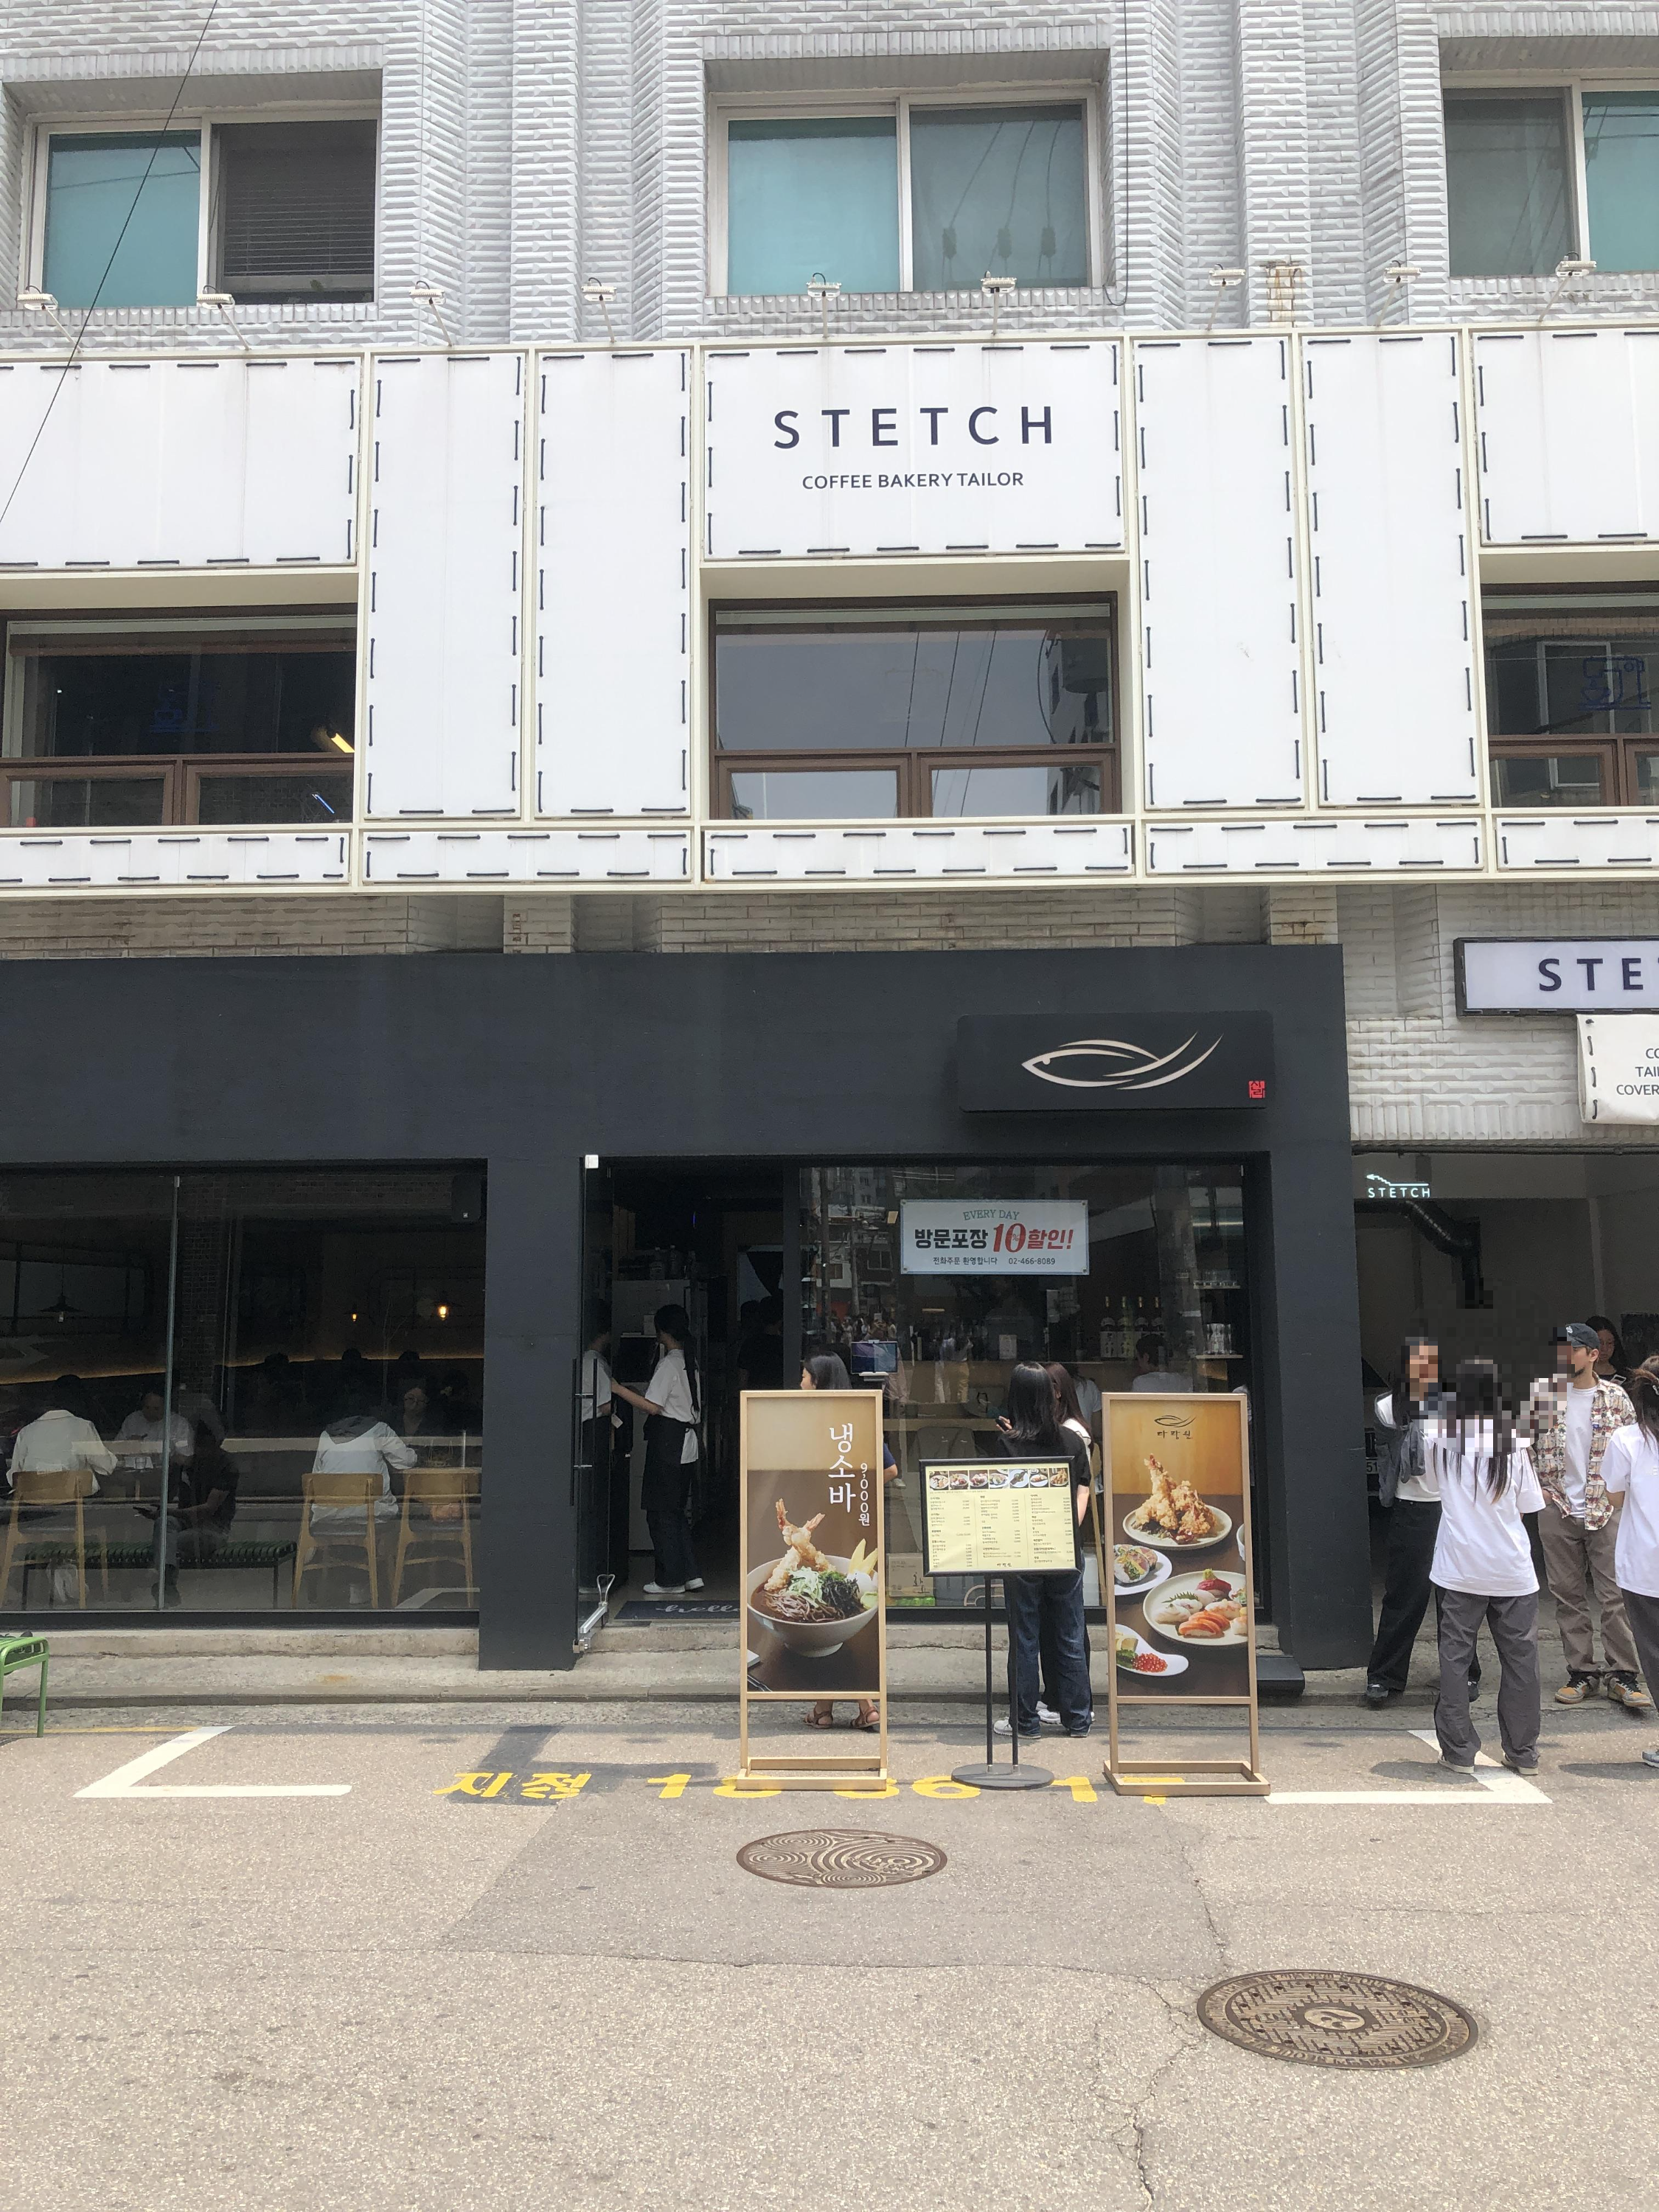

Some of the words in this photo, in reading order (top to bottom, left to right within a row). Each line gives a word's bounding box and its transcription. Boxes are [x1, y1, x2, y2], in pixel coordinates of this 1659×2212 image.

[774, 406, 1052, 449] STETCH
[802, 475, 872, 490] COFFEE
[878, 473, 953, 488] BAKERY
[957, 472, 1024, 487] TAILOR
[1538, 958, 1659, 992] STE
[1635, 1066, 1659, 1077] TAI
[1368, 1187, 1430, 1198] STETCH
[963, 1209, 996, 1221] EVERY
[998, 1209, 1020, 1220] DAY
[914, 1228, 989, 1249] 방문포장
[933, 1256, 961, 1265] 전화주문
[962, 1256, 998, 1265] 환영합니다
[1008, 1257, 1056, 1265] 02-466-8089
[827, 1422, 856, 1513] 냉소바
[858, 1463, 870, 1526] 9,000원
[655, 1604, 740, 1613] hell
[432, 1772, 592, 1800] 지정
